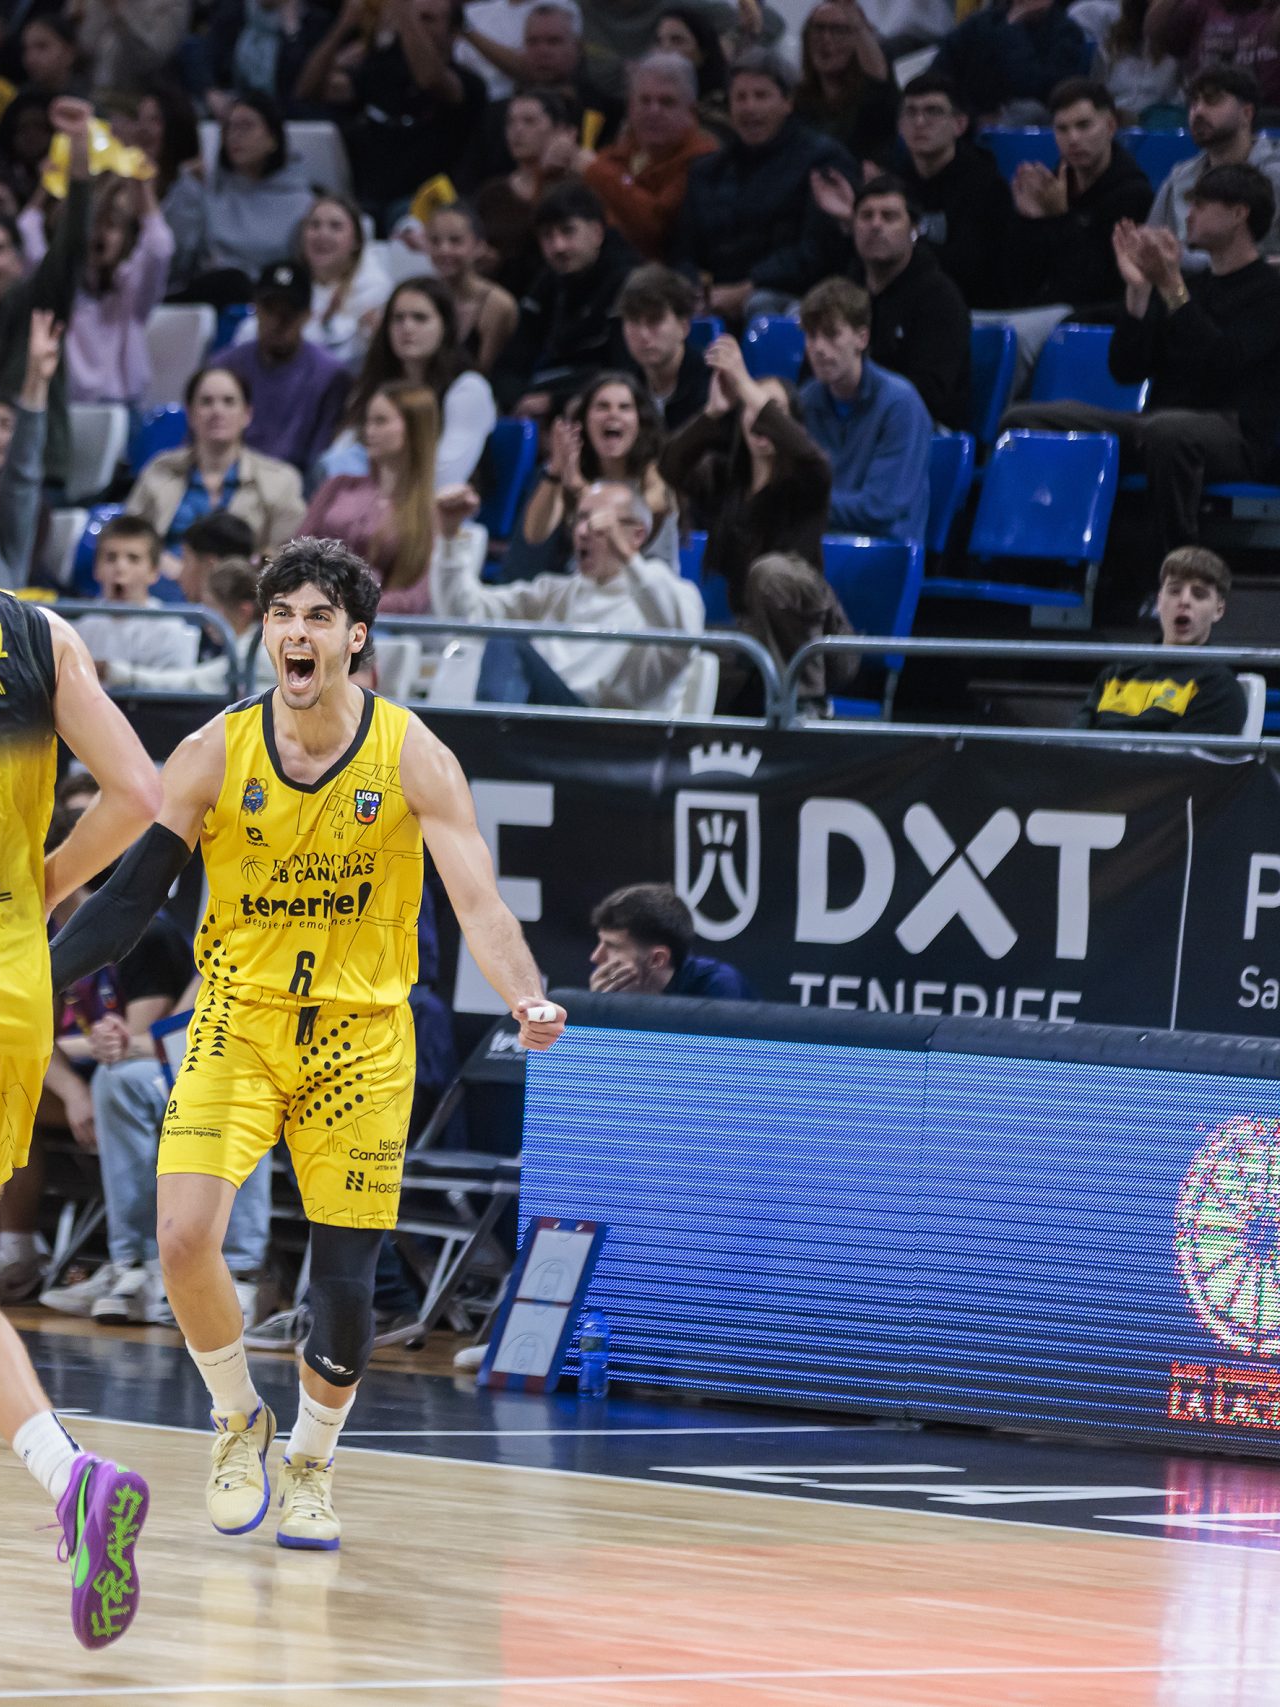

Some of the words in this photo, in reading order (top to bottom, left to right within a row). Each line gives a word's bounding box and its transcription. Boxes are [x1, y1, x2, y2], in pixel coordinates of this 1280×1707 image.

[356, 791, 380, 802] LIGA
[795, 797, 1126, 960] DXT
[299, 916, 352, 932] emocines
[288, 950, 316, 998] 6
